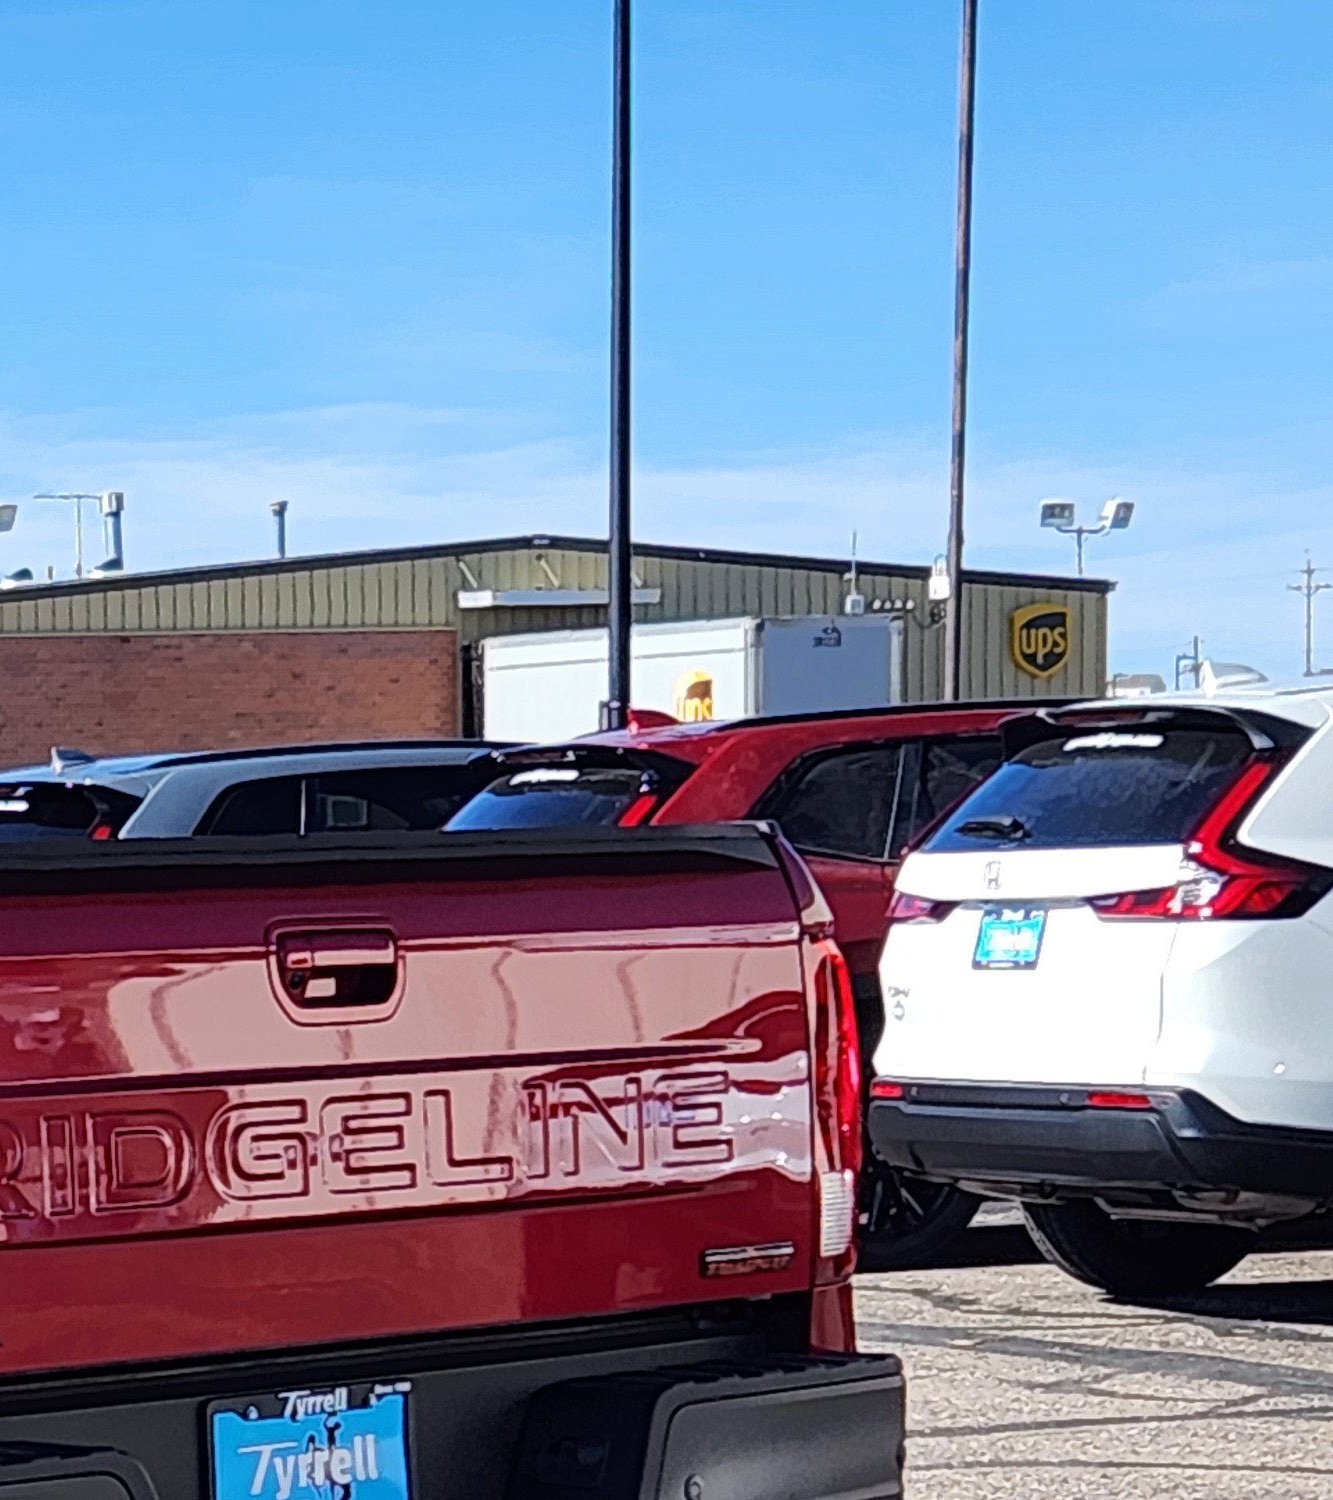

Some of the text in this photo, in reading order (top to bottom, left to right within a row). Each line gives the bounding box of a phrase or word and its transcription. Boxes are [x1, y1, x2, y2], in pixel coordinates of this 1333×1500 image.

[1022, 627, 1066, 665] ups
[278, 1386, 349, 1421] Tyrrell
[237, 1433, 379, 1500] Tyrrell
